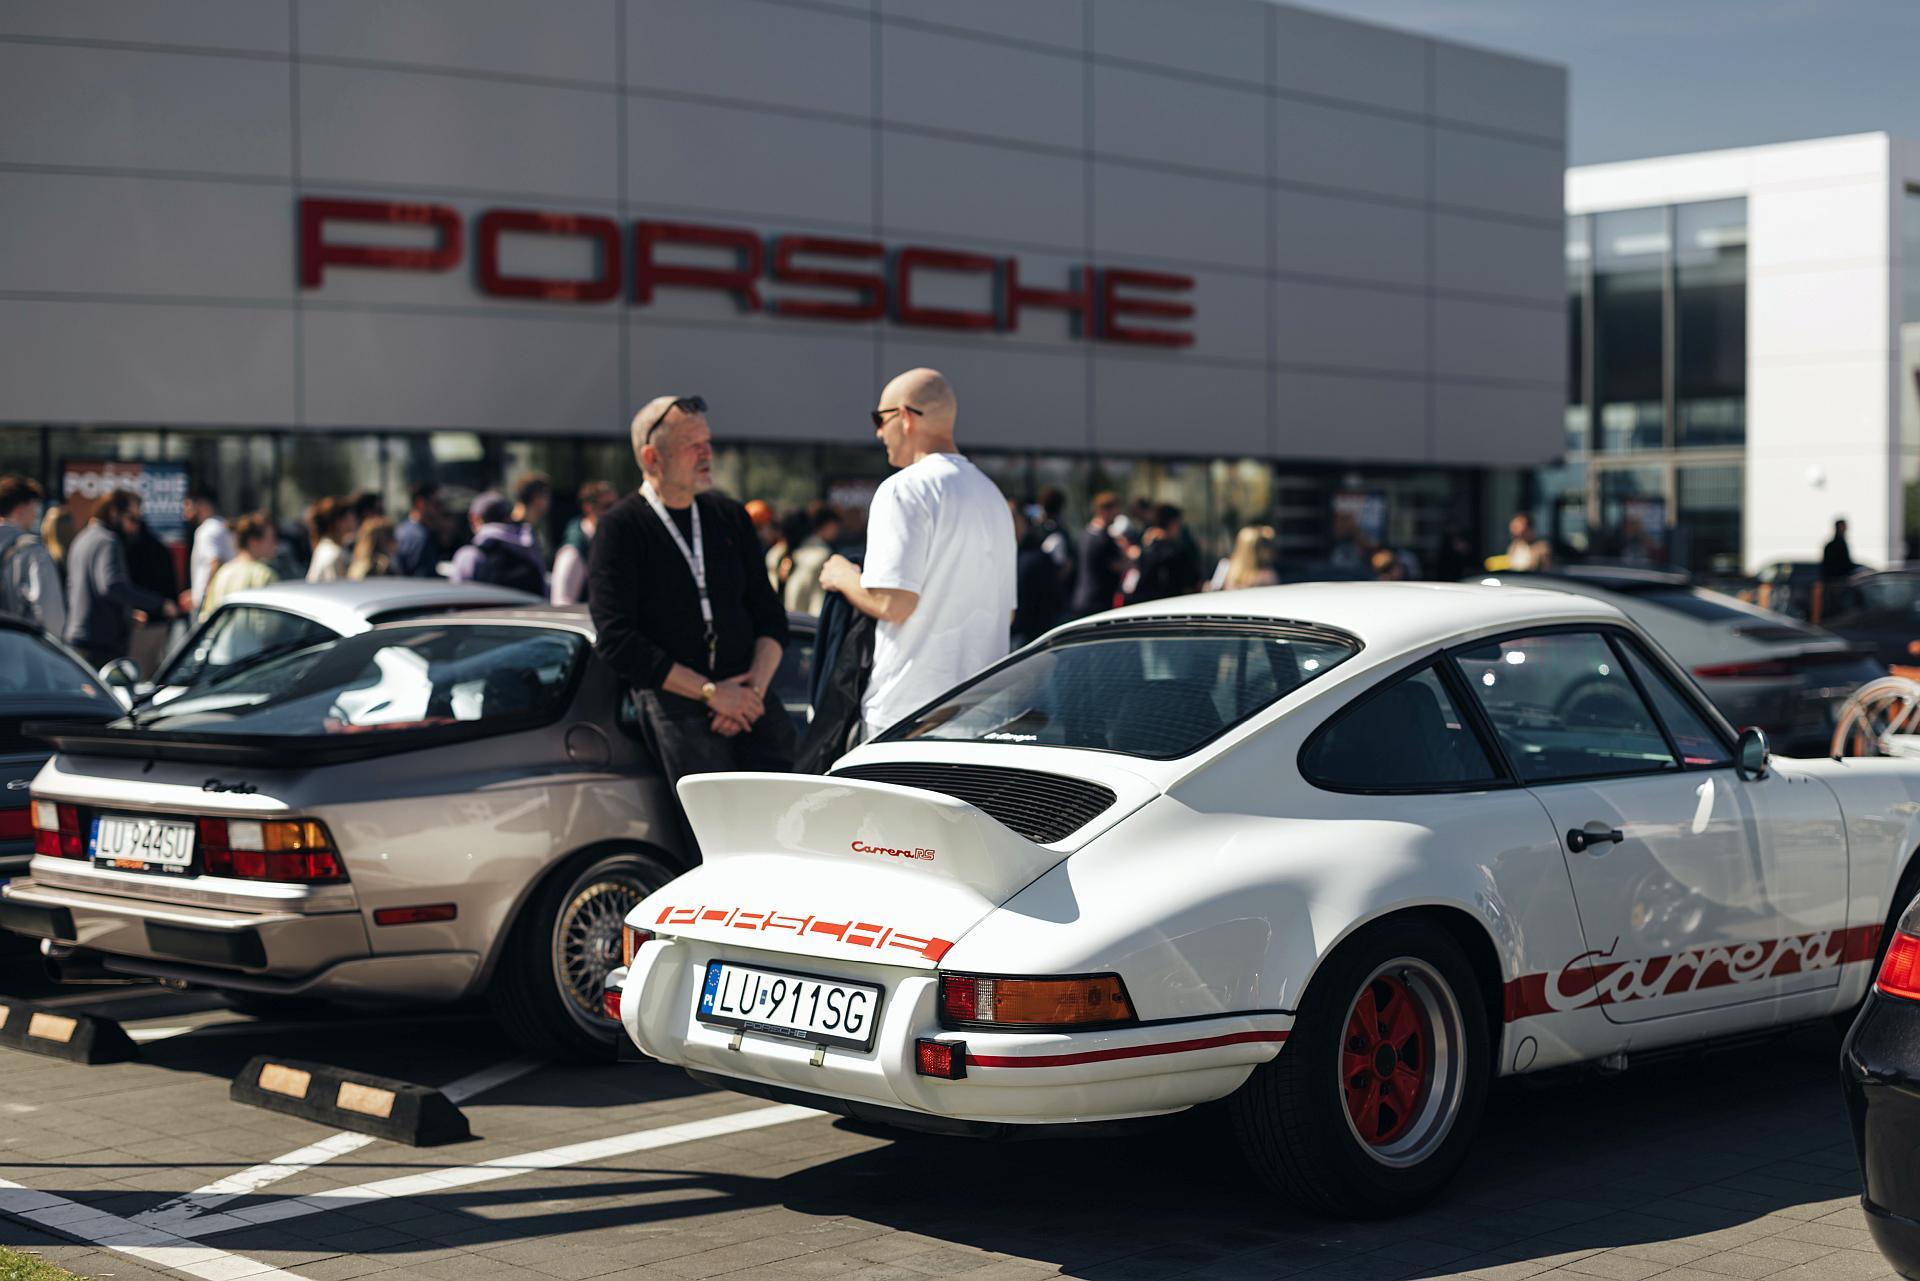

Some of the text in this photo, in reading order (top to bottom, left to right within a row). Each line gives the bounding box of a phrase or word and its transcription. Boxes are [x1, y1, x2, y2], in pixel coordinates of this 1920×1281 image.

[297, 196, 1196, 348] PORSCHE
[655, 904, 942, 962] PORSCHE
[703, 993, 713, 1007] PL
[1543, 930, 1845, 1012] Carrera
[743, 1021, 808, 1039] PORSCHE
